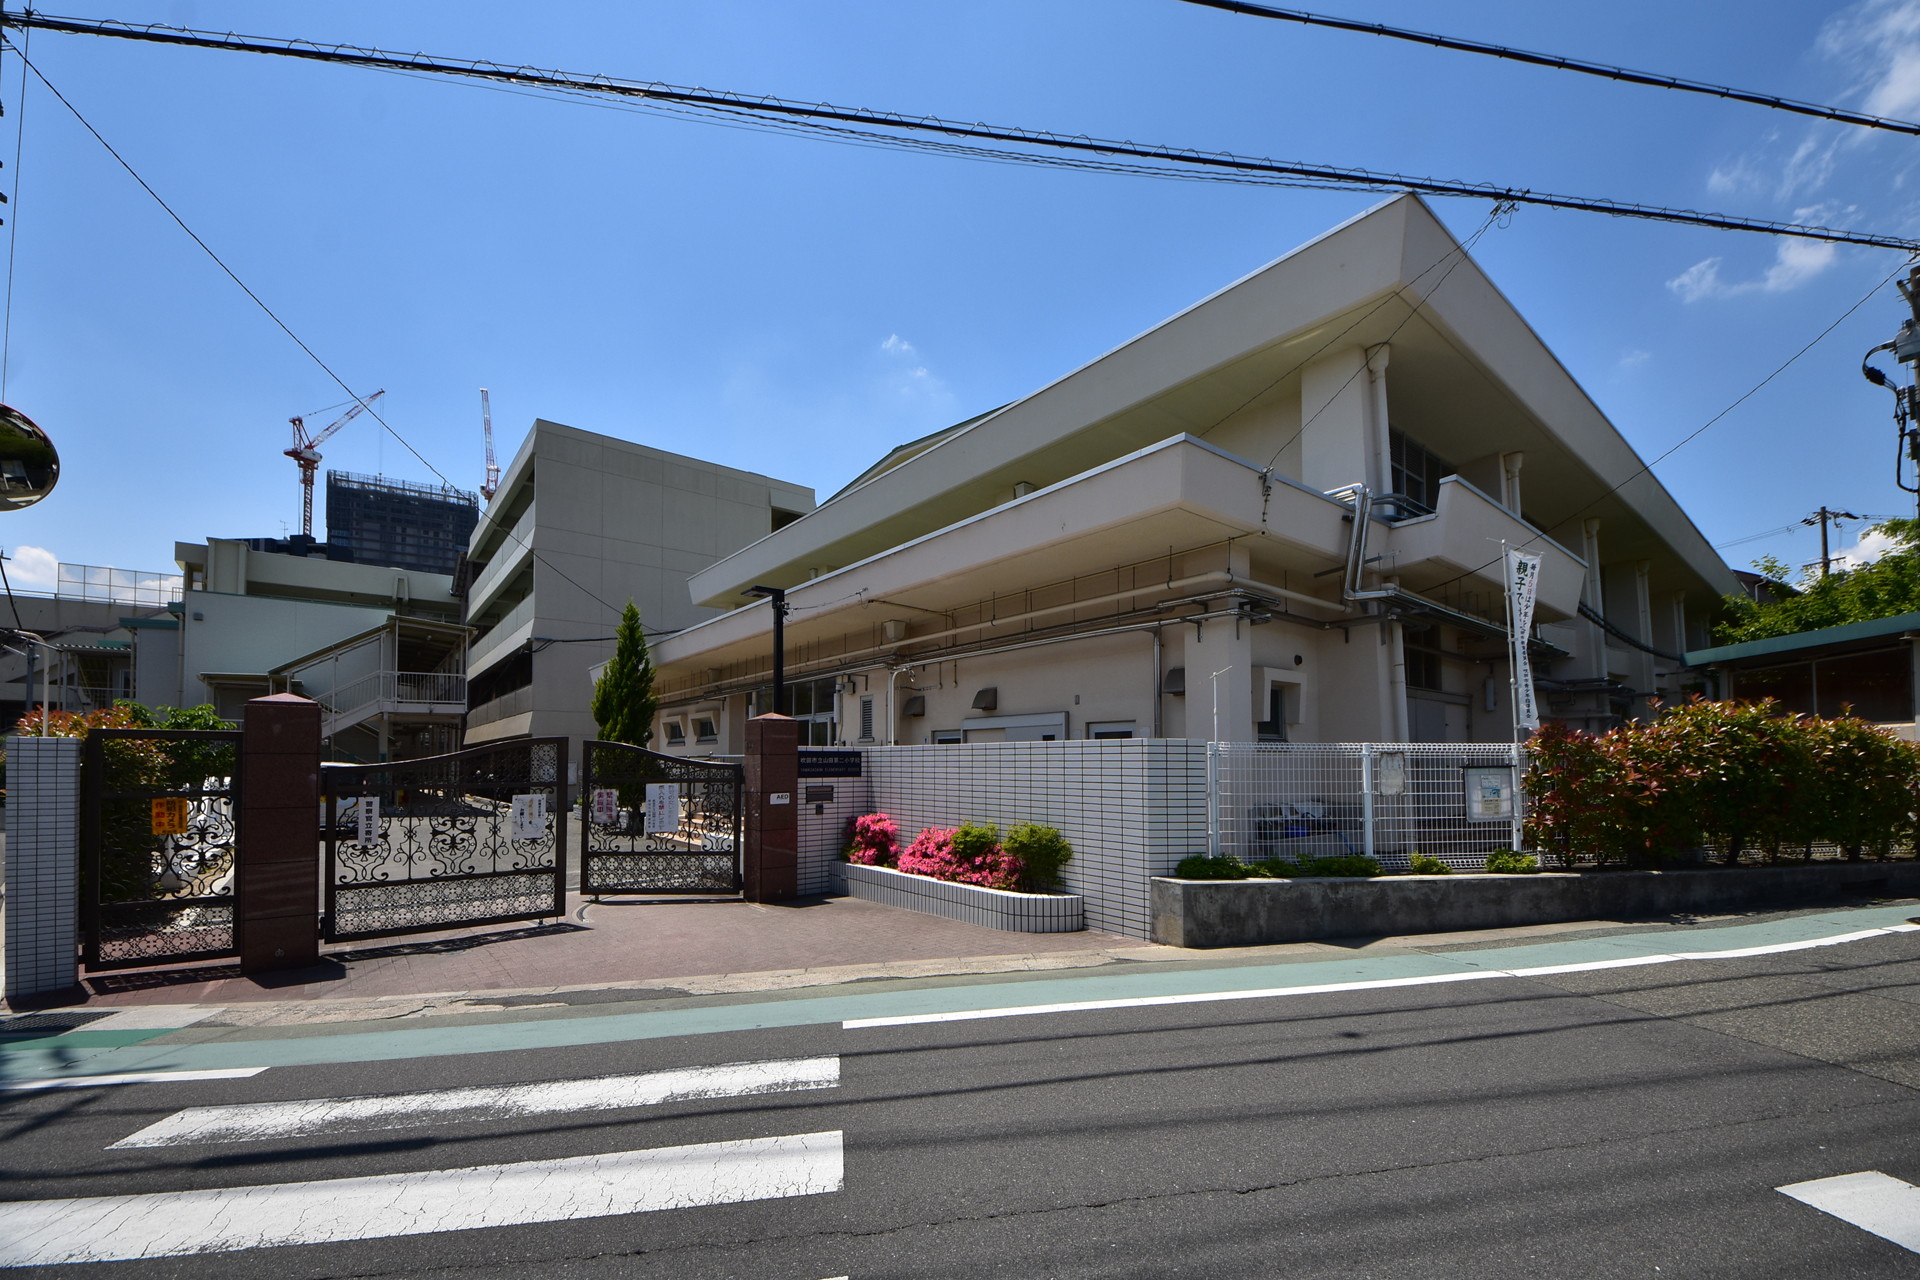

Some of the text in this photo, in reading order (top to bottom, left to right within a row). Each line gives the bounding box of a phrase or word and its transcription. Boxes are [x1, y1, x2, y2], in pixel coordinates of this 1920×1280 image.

[155, 801, 165, 827] 作動中
[364, 801, 373, 843] 警察官立寄所
